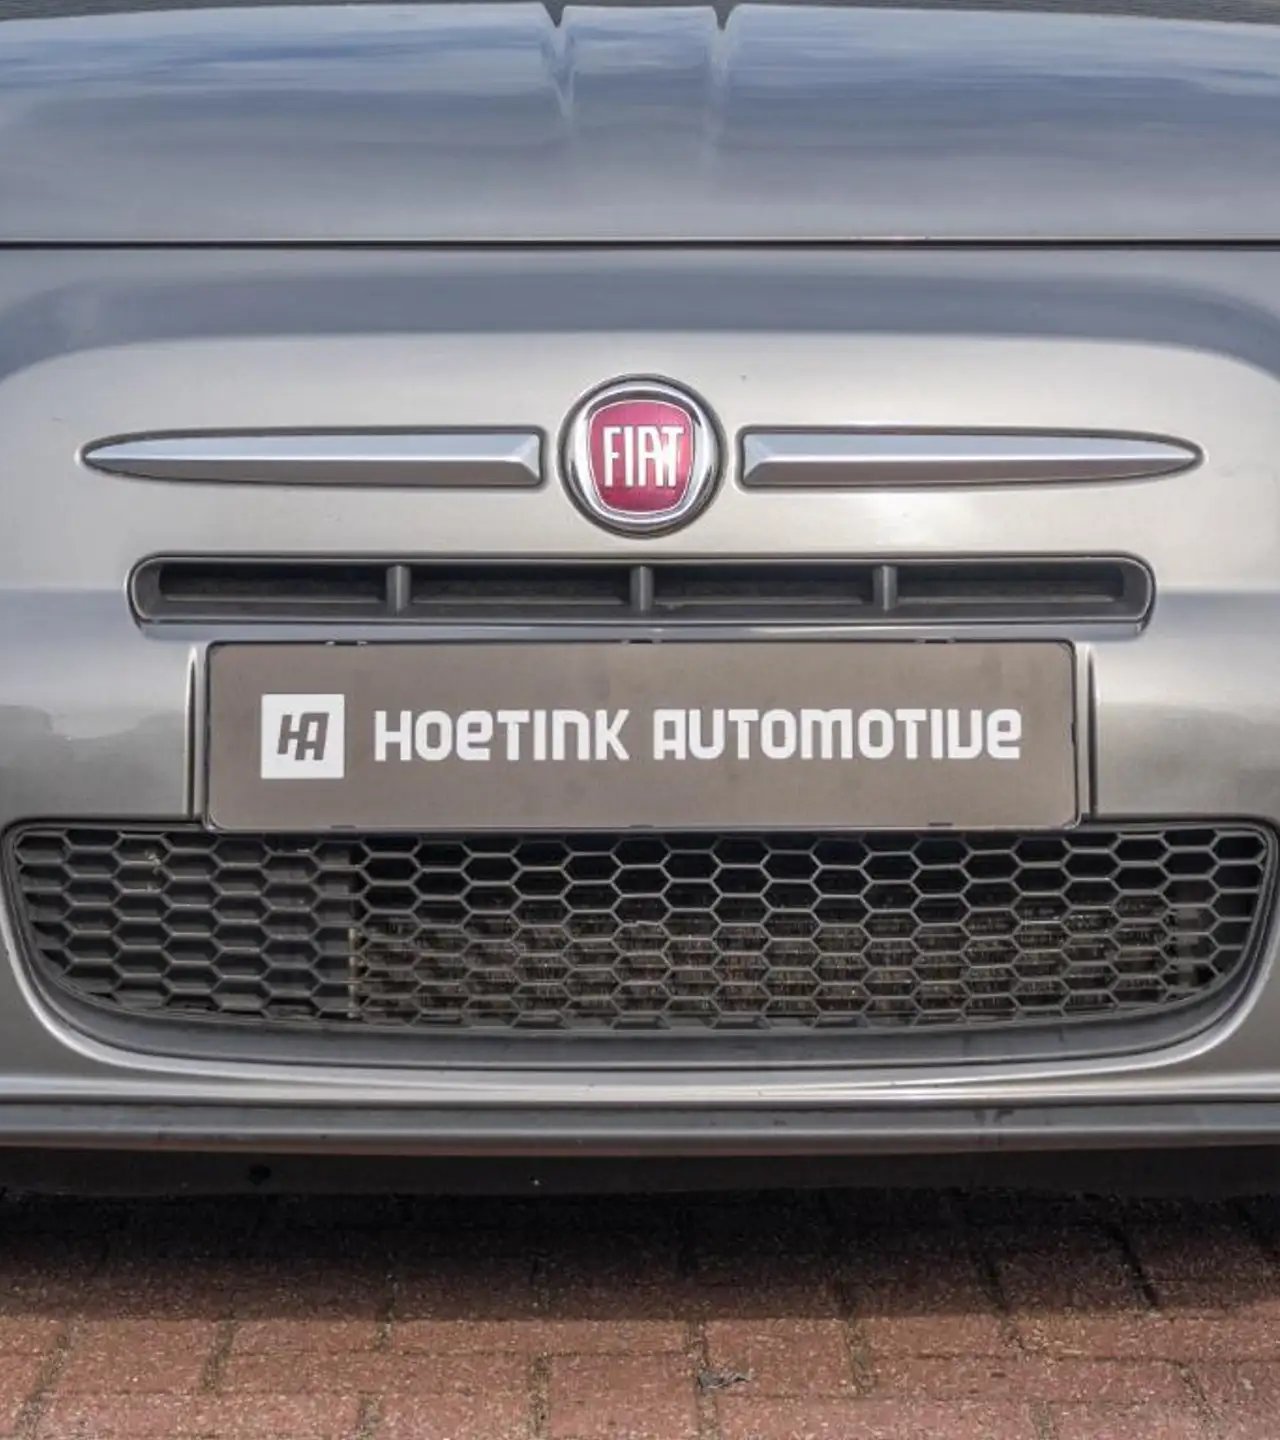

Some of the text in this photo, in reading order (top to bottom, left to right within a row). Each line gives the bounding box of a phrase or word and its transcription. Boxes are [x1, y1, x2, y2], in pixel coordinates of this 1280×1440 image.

[603, 426, 684, 487] FIAT
[374, 709, 631, 762] HOETINK
[652, 707, 1024, 761] AUTOMOTIVE
